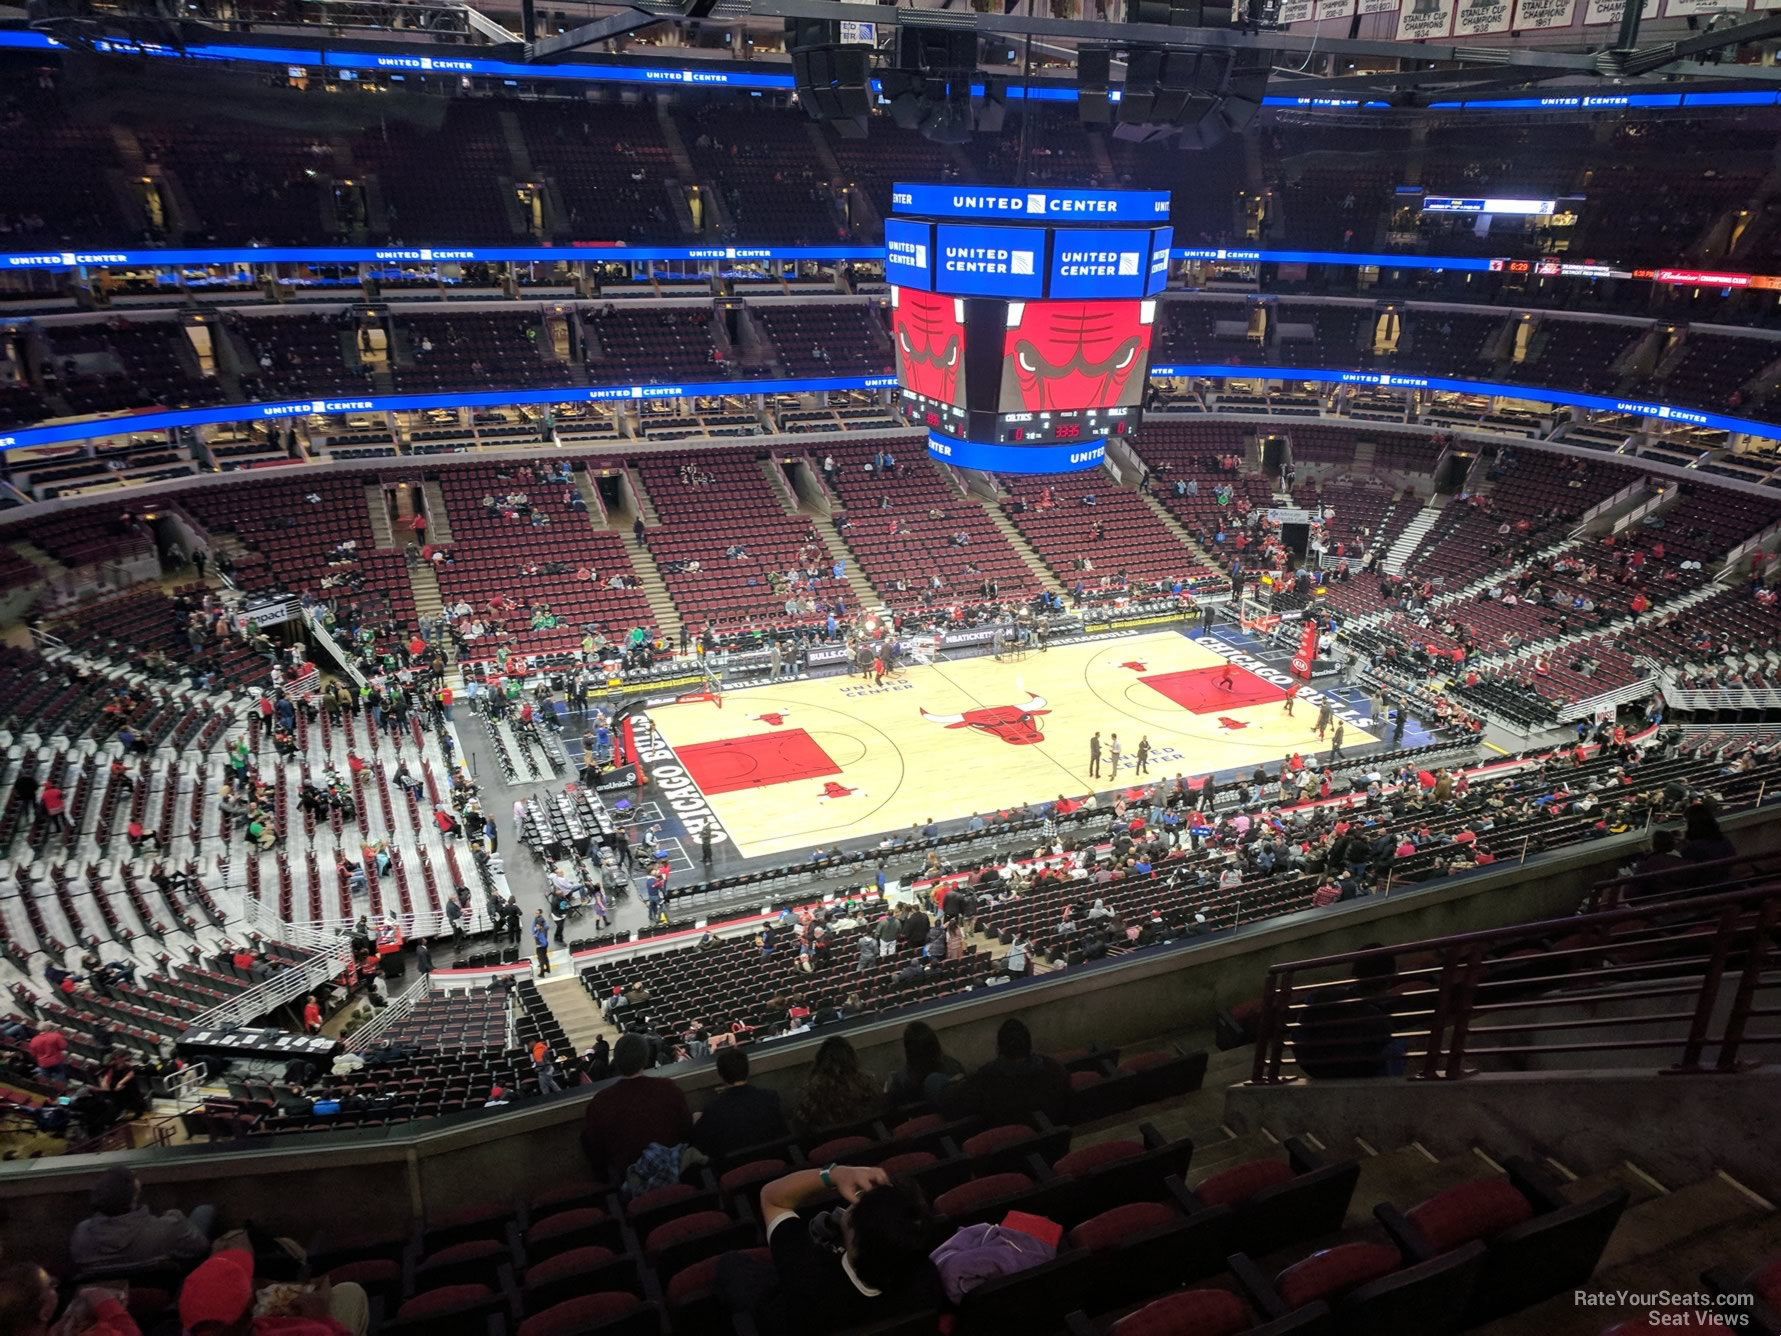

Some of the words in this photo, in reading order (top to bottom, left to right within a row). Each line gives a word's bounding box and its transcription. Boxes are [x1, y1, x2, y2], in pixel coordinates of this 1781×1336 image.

[1403, 13, 1431, 22] STANLEY
[1434, 12, 1448, 20] CUP
[1460, 6, 1490, 18] STANLEY
[1492, 5, 1506, 14] CUP
[1523, 8, 1566, 19] CHAMPIONS
[1405, 21, 1444, 31] CHAMPIONS
[1462, 15, 1502, 26] CHAMPIONS
[1414, 30, 1430, 38] 1934
[378, 58, 420, 68] UNITED
[433, 60, 472, 70] CENTER
[646, 72, 682, 80] UNITED
[693, 73, 728, 82] CENTER
[953, 196, 1023, 209] UNITED
[1050, 200, 1117, 212] CENTER
[888, 241, 915, 253] UNITED
[946, 248, 1008, 260] UNITED
[1062, 252, 1117, 262] UNITED
[10, 256, 60, 265] UNITED
[889, 254, 915, 266] CENTER
[946, 261, 1007, 274] CENTER
[1061, 266, 1115, 276] CENTER
[1661, 272, 1698, 281] Budweiser
[1391, 378, 1428, 386] CENTER
[264, 405, 310, 415] UNITED
[326, 402, 373, 410] CENTER
[1618, 403, 1658, 414] UNITED
[1670, 410, 1707, 423] CENTER
[809, 650, 849, 661] BULLS.CO
[1194, 636, 1294, 685] CHICAGO
[1294, 660, 1306, 670] KIA
[840, 680, 908, 692] UNIED
[846, 684, 914, 697] CENTER
